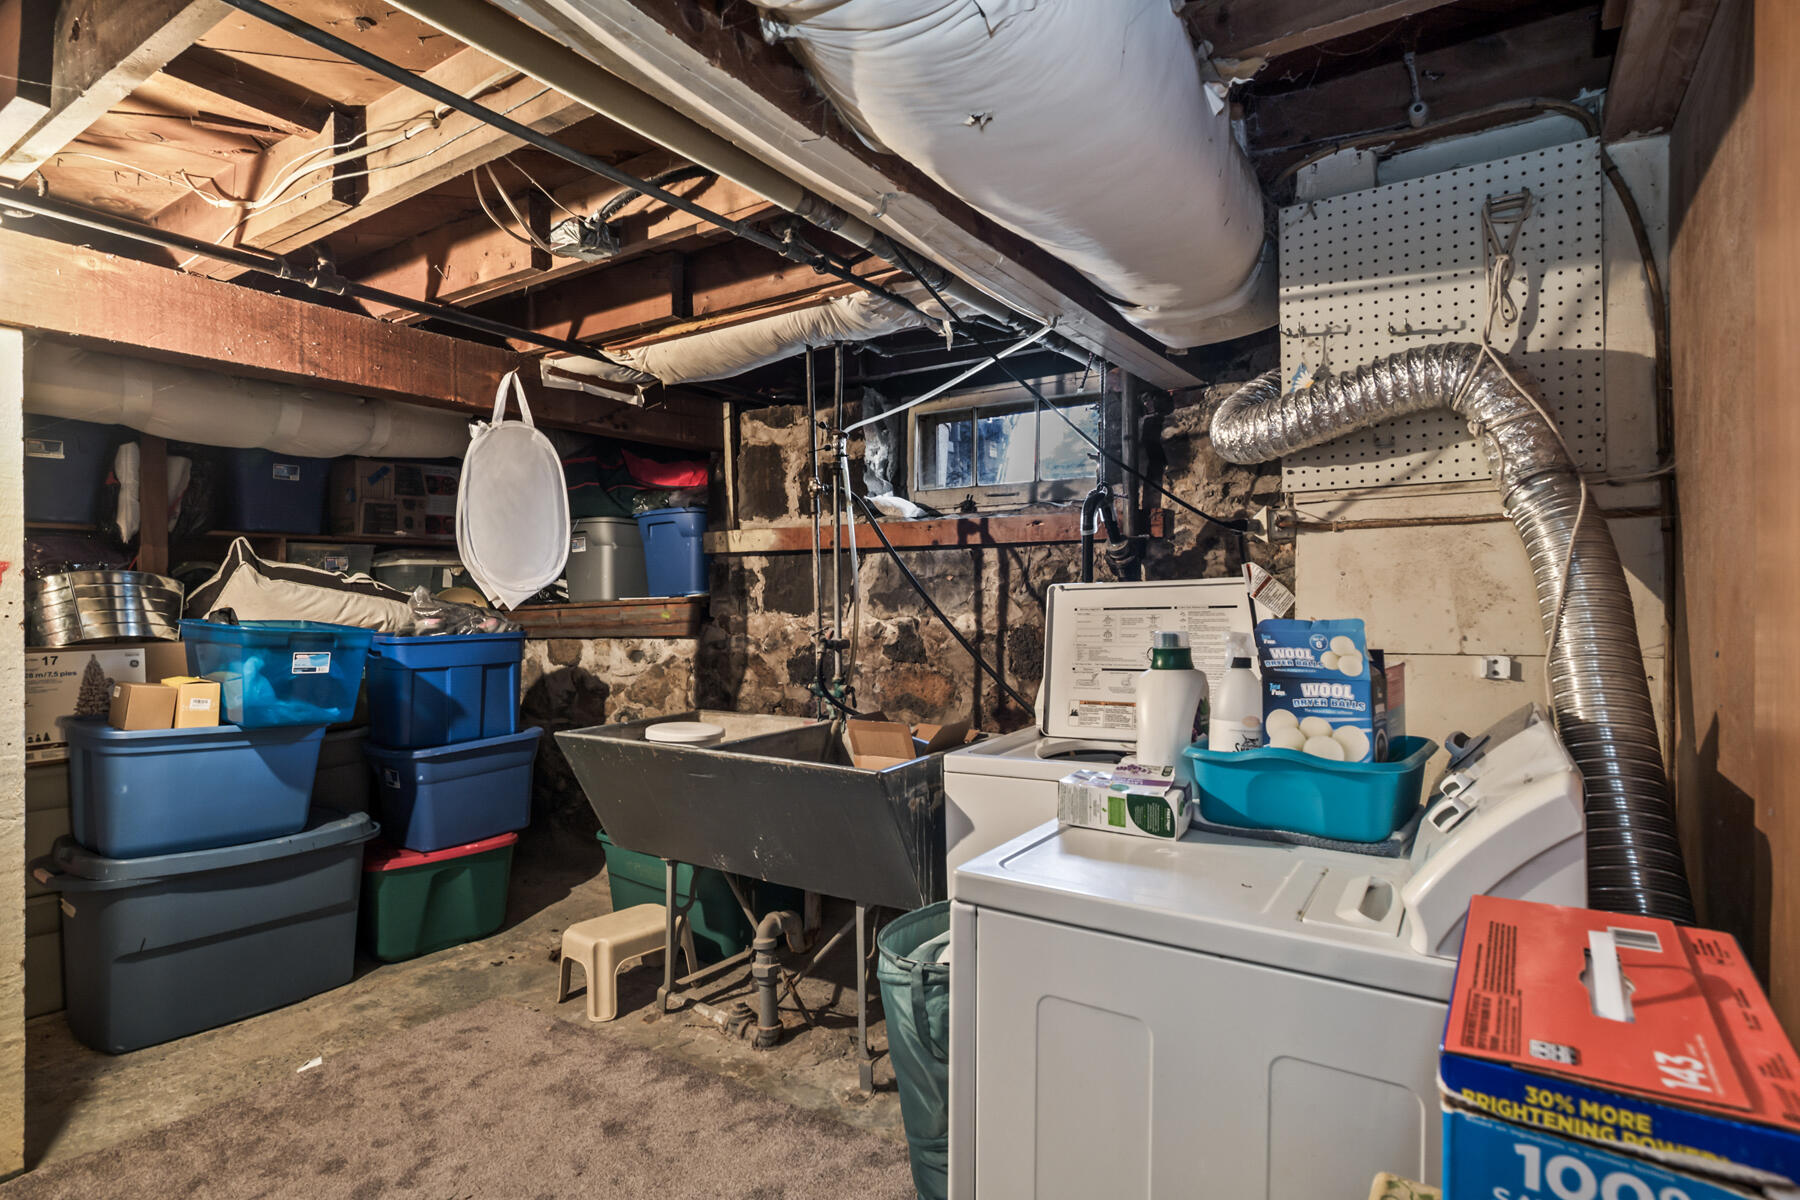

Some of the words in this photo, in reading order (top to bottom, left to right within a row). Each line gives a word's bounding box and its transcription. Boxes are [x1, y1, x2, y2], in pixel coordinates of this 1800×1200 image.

[41, 656, 58, 666] 17
[1269, 647, 1315, 660] WOOL
[1264, 659, 1294, 668] DRYER
[1300, 682, 1355, 700] WOOL
[1292, 698, 1328, 708] DRYER
[1330, 699, 1366, 712] BALLS
[1653, 1051, 1713, 1092] 143
[1524, 1084, 1576, 1115] 30%
[1579, 1099, 1653, 1135] MORE
[1513, 1143, 1693, 1200] 100
